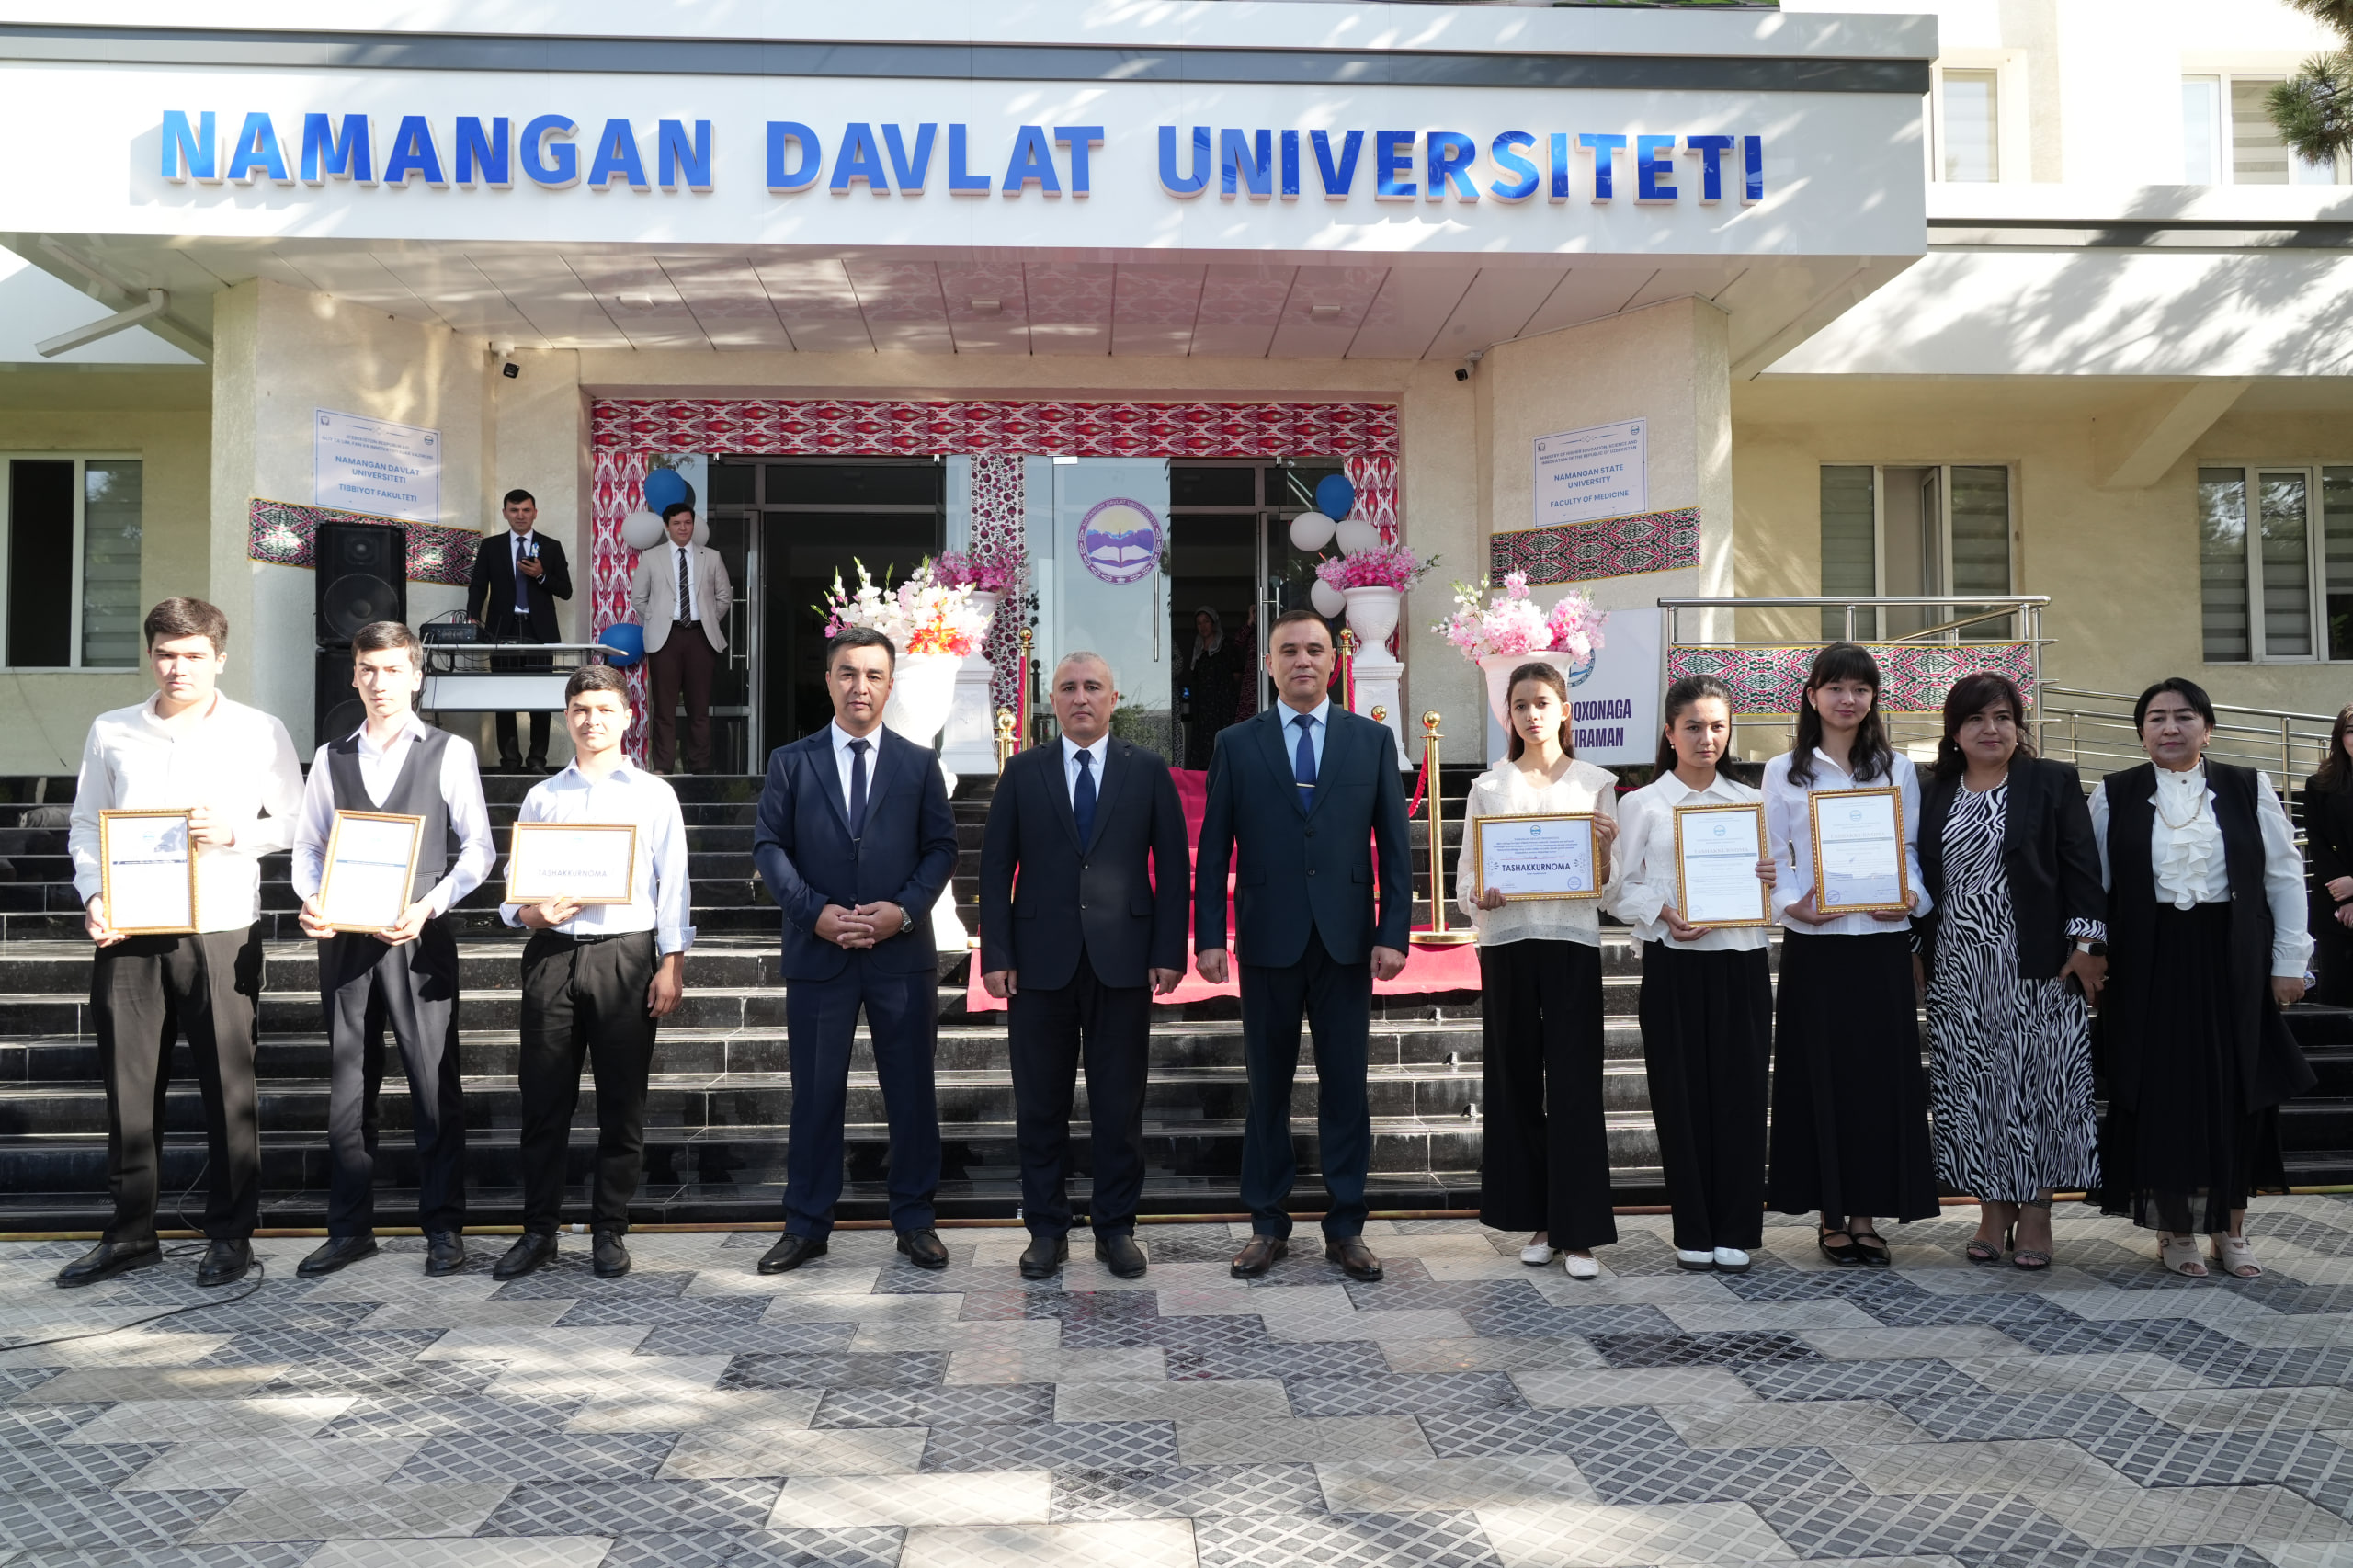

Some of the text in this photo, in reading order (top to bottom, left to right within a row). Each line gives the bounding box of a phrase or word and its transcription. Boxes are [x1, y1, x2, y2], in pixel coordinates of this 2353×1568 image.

[161, 108, 1764, 206] NAMANGAN DAVLAT UNIVERSITETI
[335, 455, 420, 476] NAMANGAN DAVLAT
[1554, 463, 1624, 482] NAMANGAN STATE
[352, 468, 406, 484] UNIVERSITETI
[1567, 475, 1611, 489] UNIVERSITY
[338, 483, 417, 503] TIBBIYOT FAKULTETI
[1550, 489, 1630, 507] FACULTY OF MEDICINE
[1571, 699, 1631, 722] QXONAGA
[538, 869, 608, 877] TASHAKKURNOMA
[1502, 862, 1571, 872] TASHAKKURNOMA
